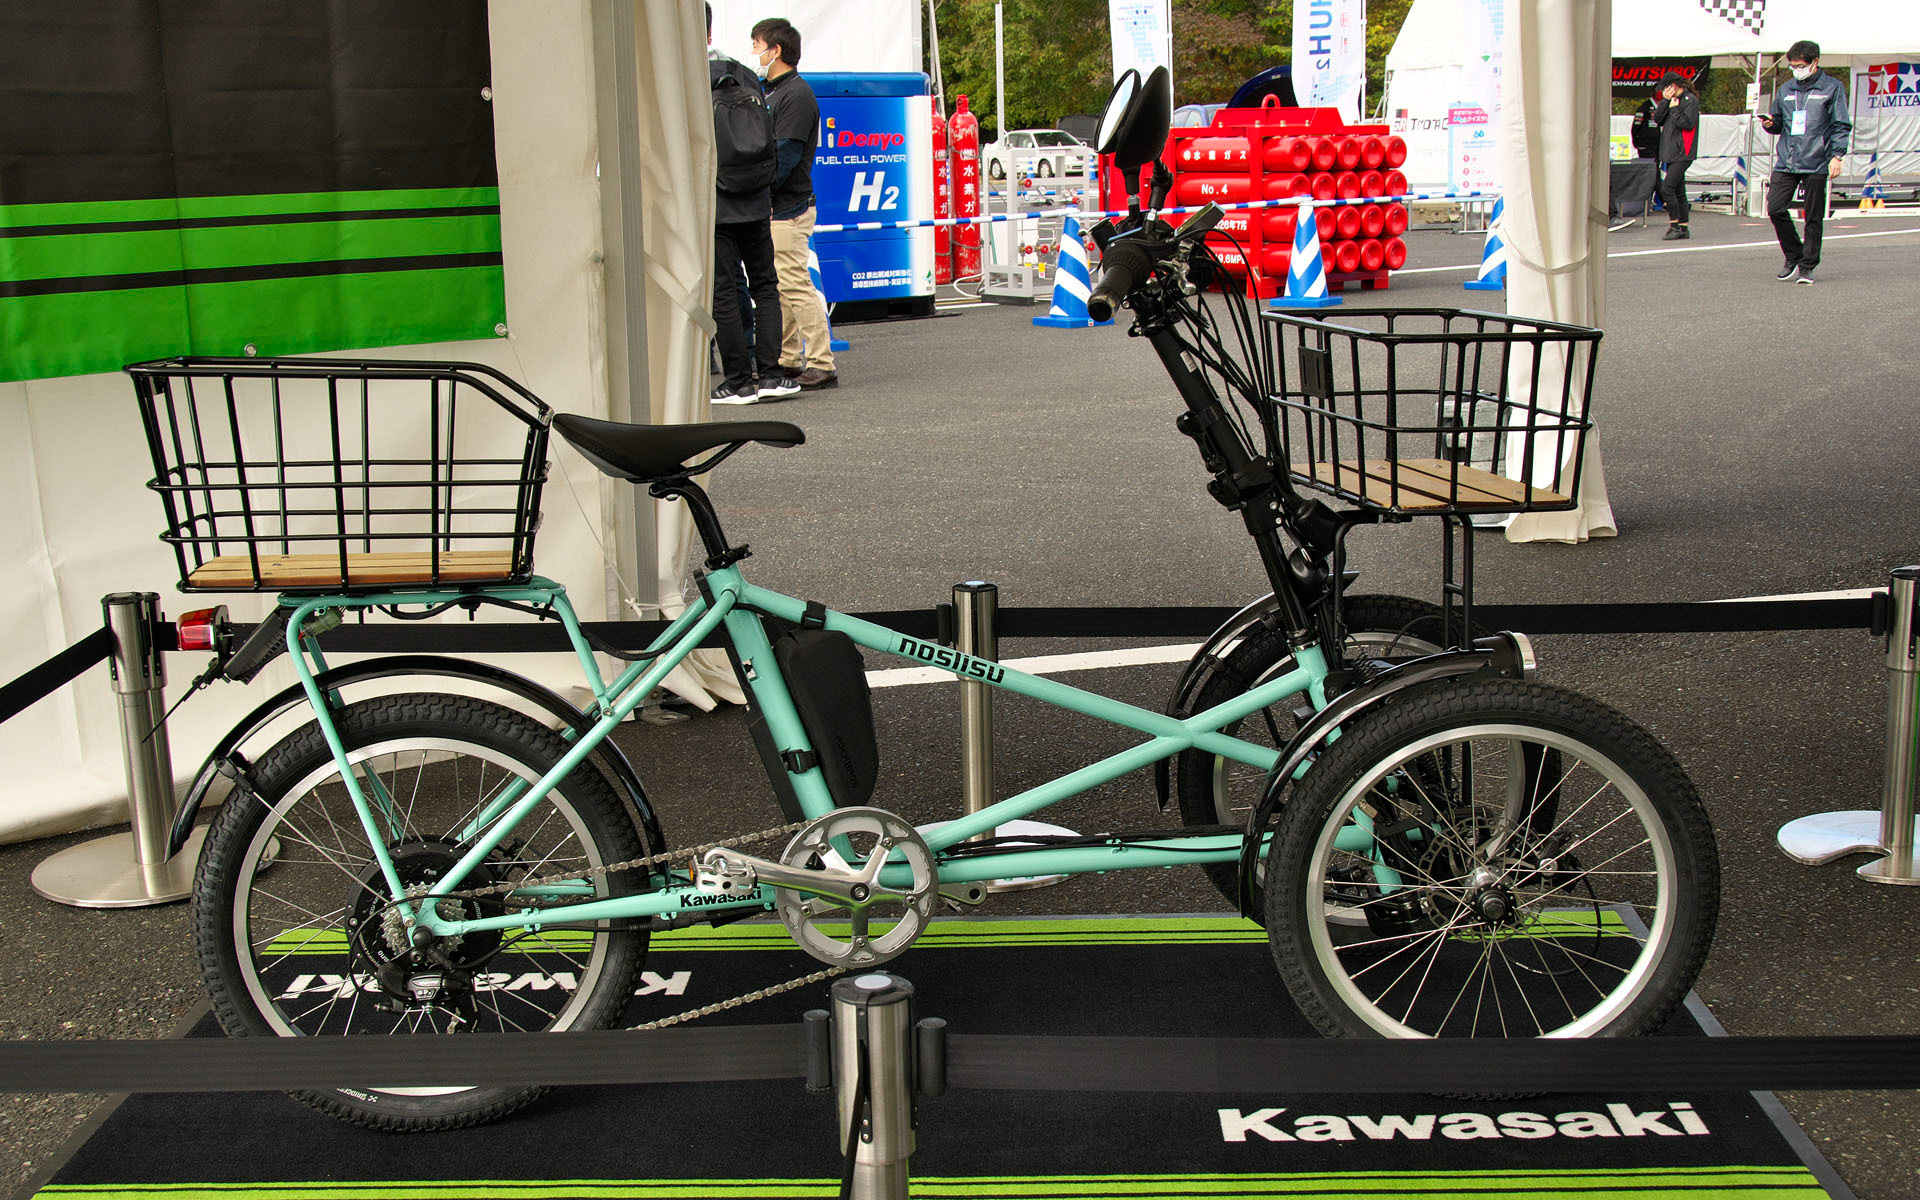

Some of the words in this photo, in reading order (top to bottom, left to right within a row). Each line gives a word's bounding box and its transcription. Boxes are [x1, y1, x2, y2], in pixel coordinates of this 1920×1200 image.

[1612, 65, 1696, 80] UJITSUBO
[1867, 95, 1920, 109] TAMIYA
[837, 130, 905, 151] Denyo
[815, 156, 842, 165] FUEL
[843, 155, 869, 164] CELL
[870, 153, 908, 163] POWER
[848, 171, 900, 212] H2
[852, 272, 866, 281] CO2
[899, 638, 1005, 684] noslisu
[680, 886, 762, 908] Kawasaki
[282, 971, 693, 999] Kwaaki
[1217, 1102, 1711, 1142] Kawasaki
